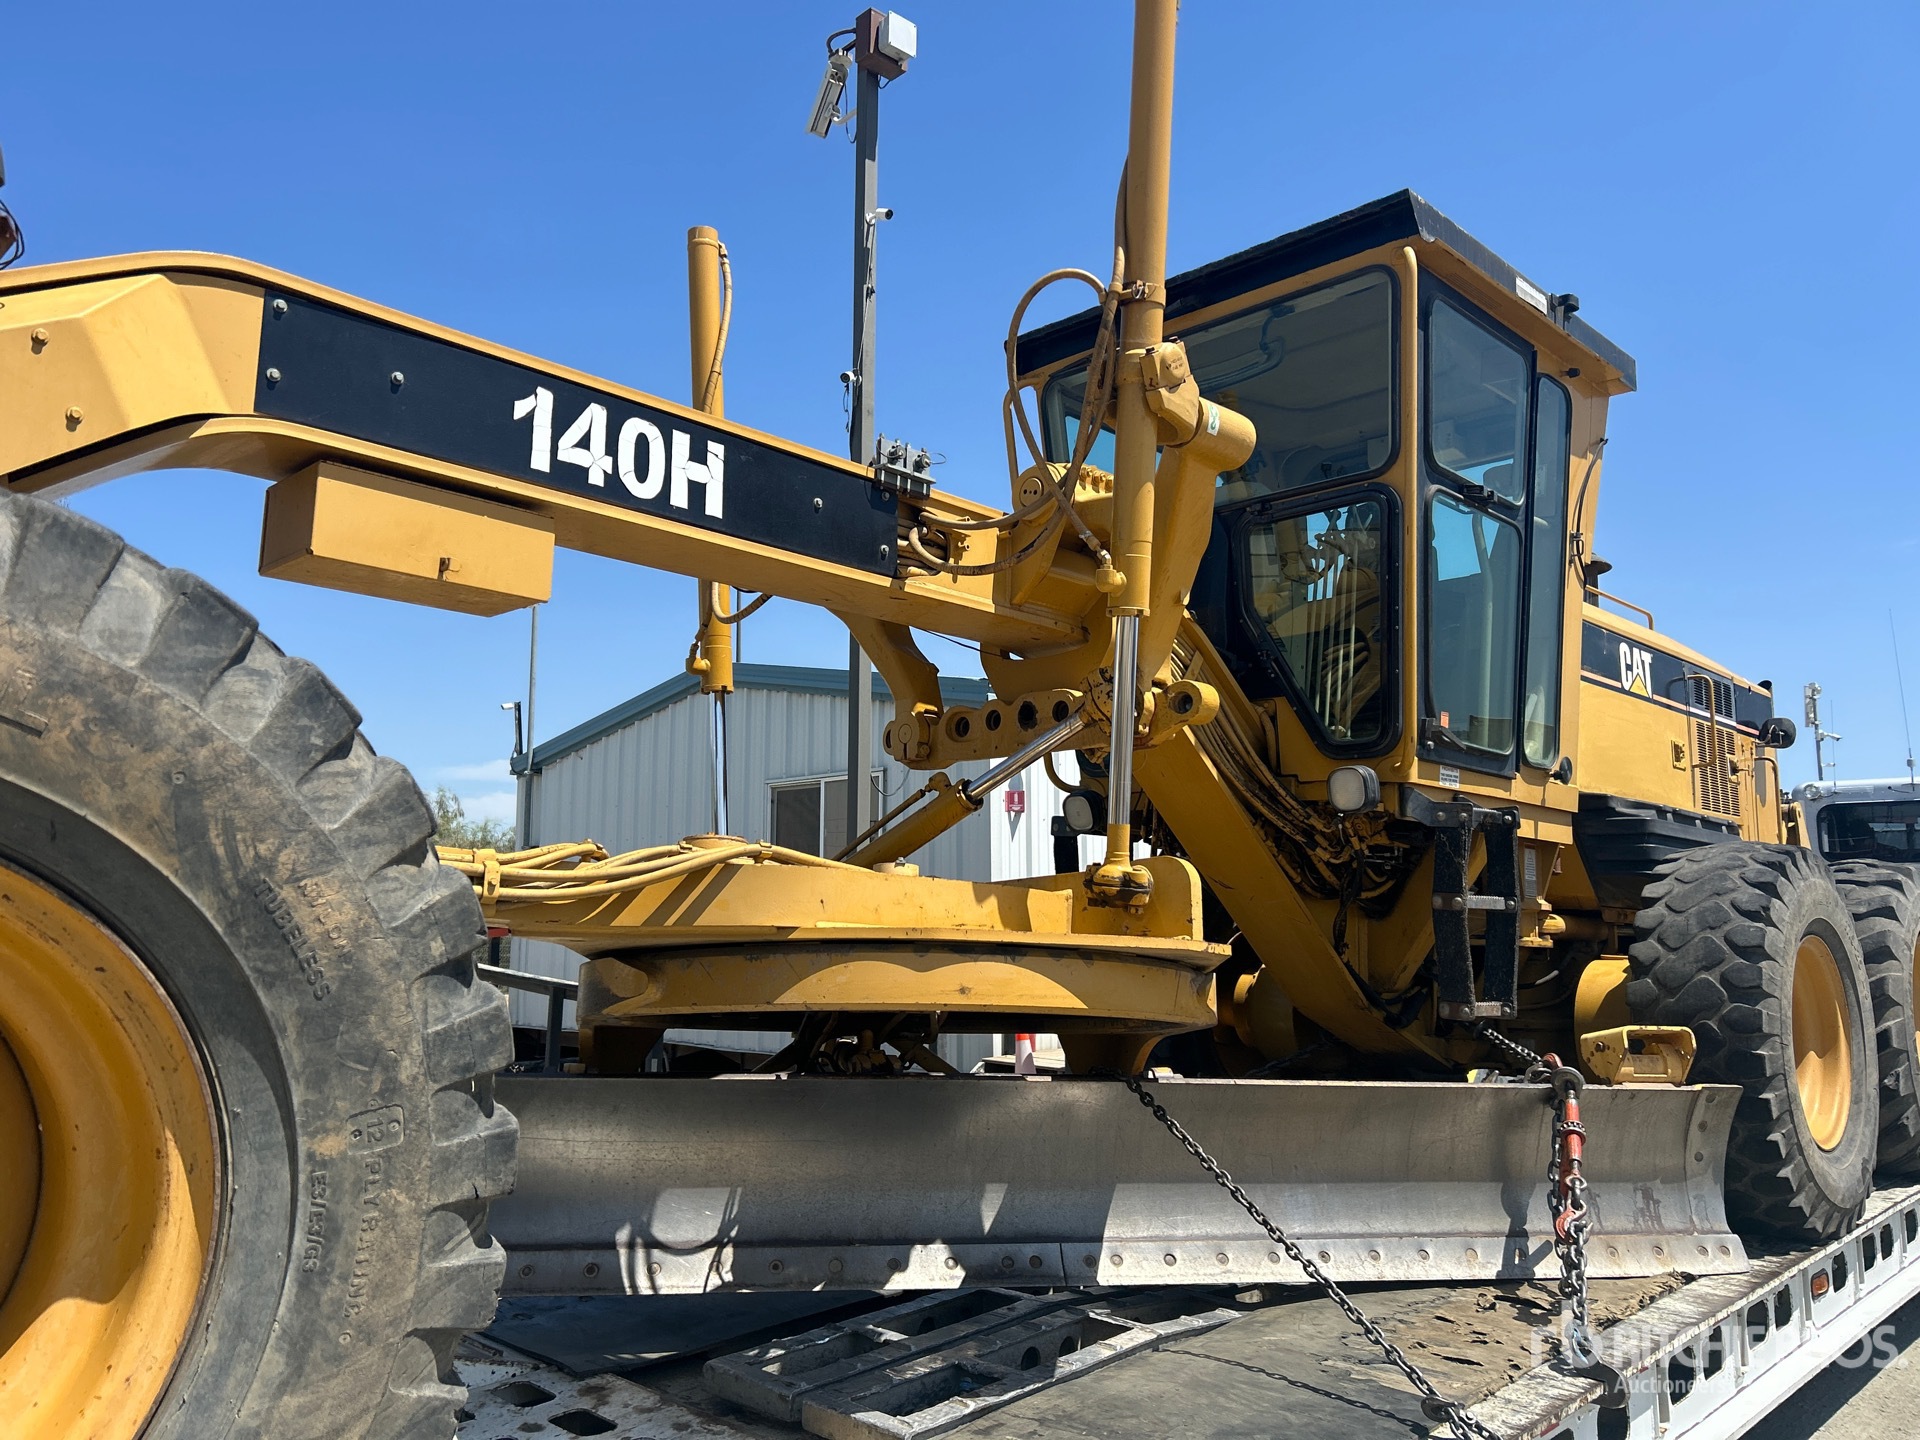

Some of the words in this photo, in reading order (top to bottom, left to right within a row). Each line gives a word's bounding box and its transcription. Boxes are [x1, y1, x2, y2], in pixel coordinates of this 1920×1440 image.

[513, 386, 724, 519] 140H
[1619, 642, 1653, 698] CAT
[254, 878, 331, 1001] TUBELESS
[367, 1118, 384, 1143] 12
[364, 1159, 382, 1206] PLY
[344, 1211, 380, 1318] RATING
